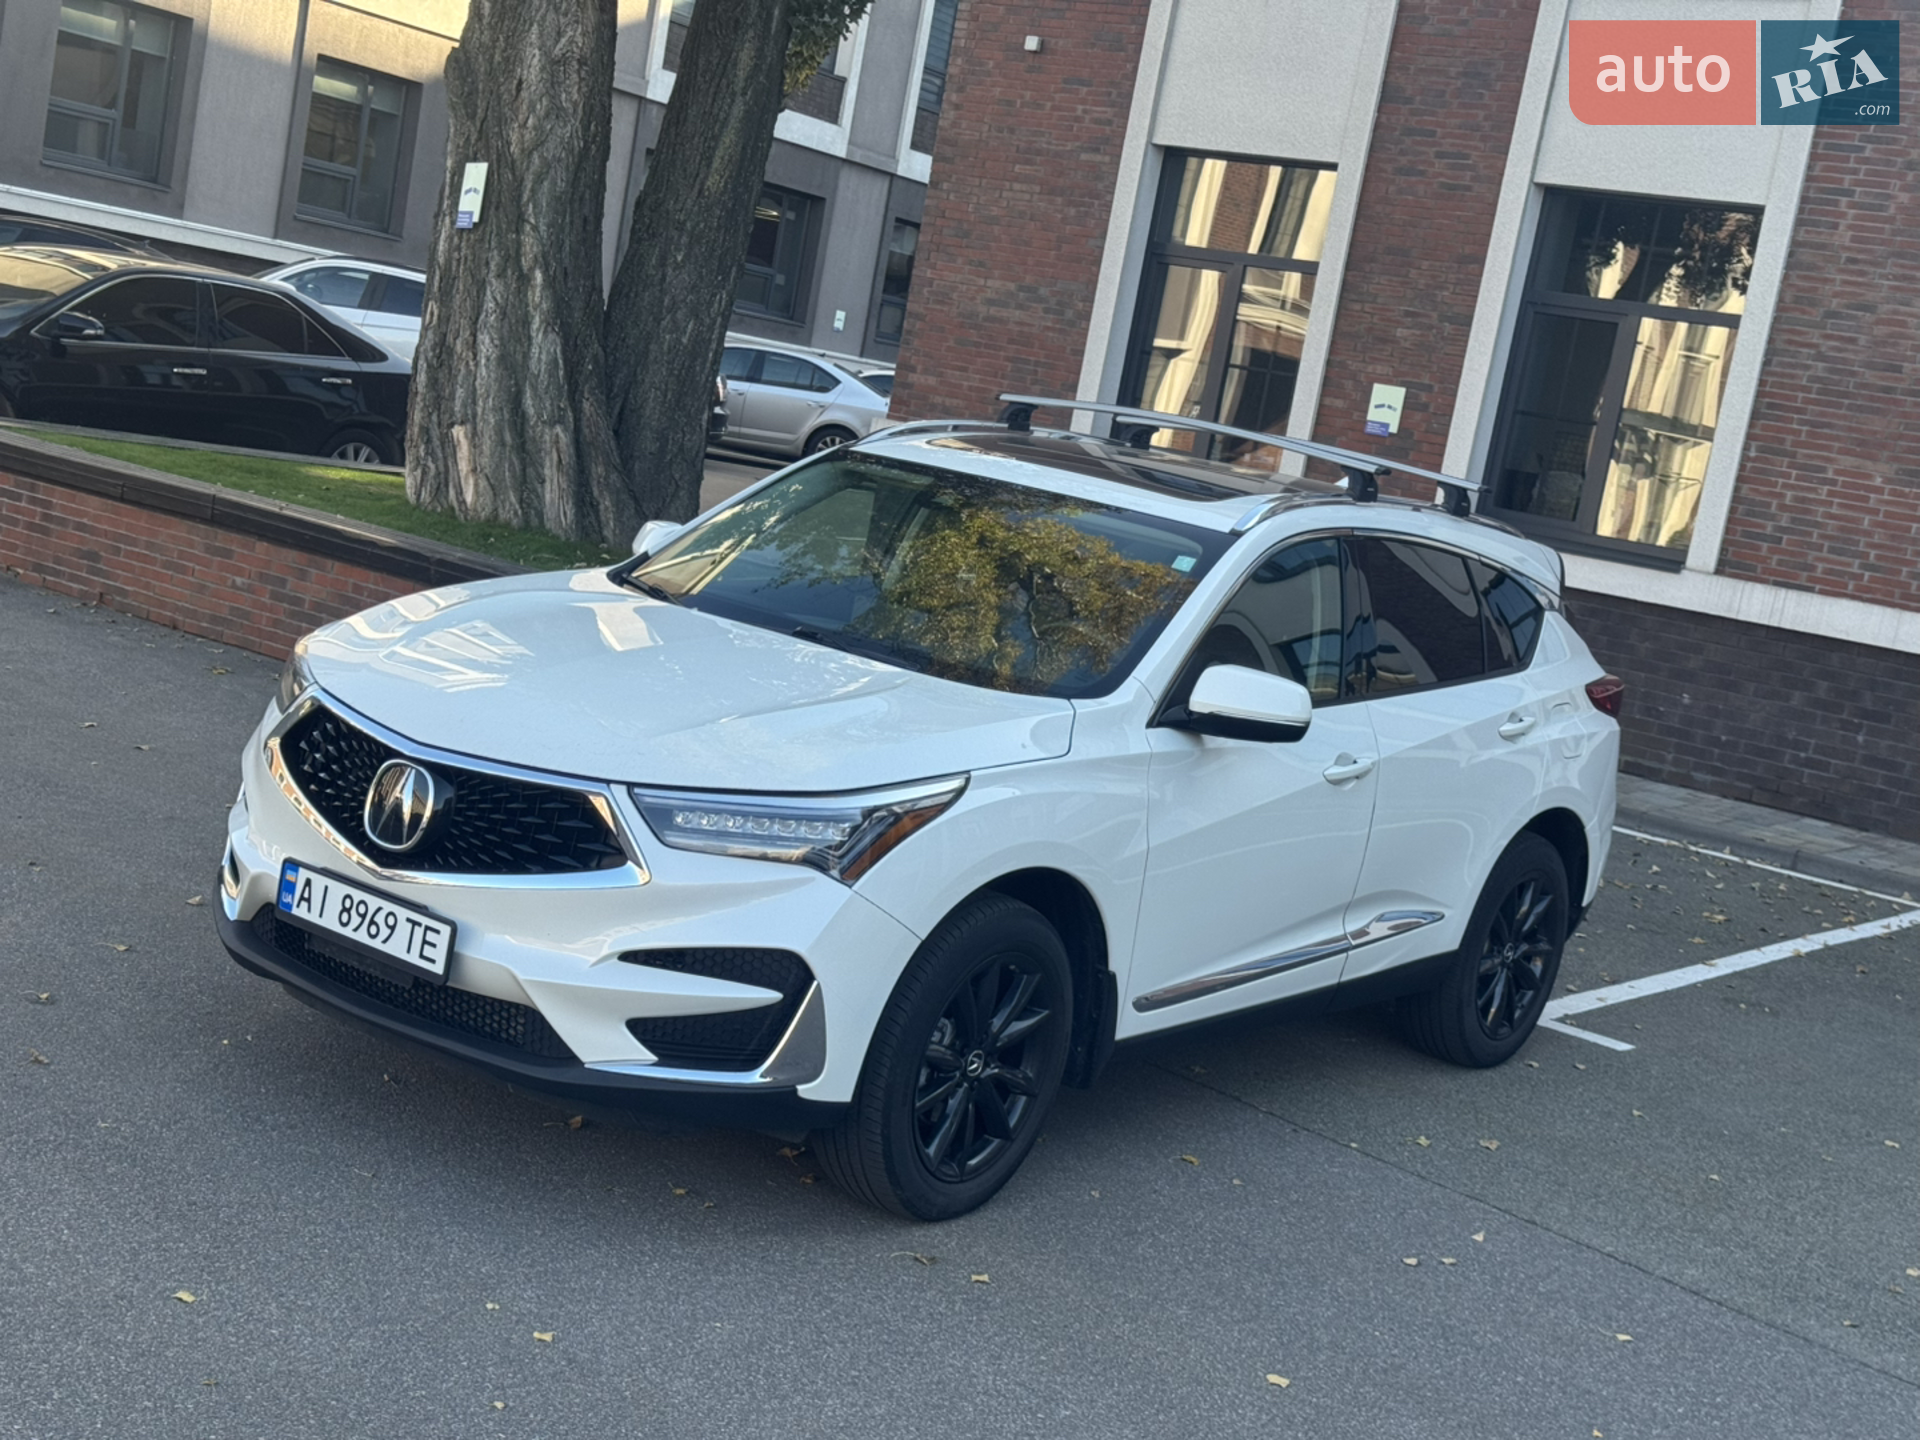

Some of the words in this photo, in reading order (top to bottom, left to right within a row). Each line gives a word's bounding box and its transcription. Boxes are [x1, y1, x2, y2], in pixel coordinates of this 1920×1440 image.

[296, 877, 328, 918] AI
[338, 893, 398, 945] 8969
[405, 917, 441, 964] TE
